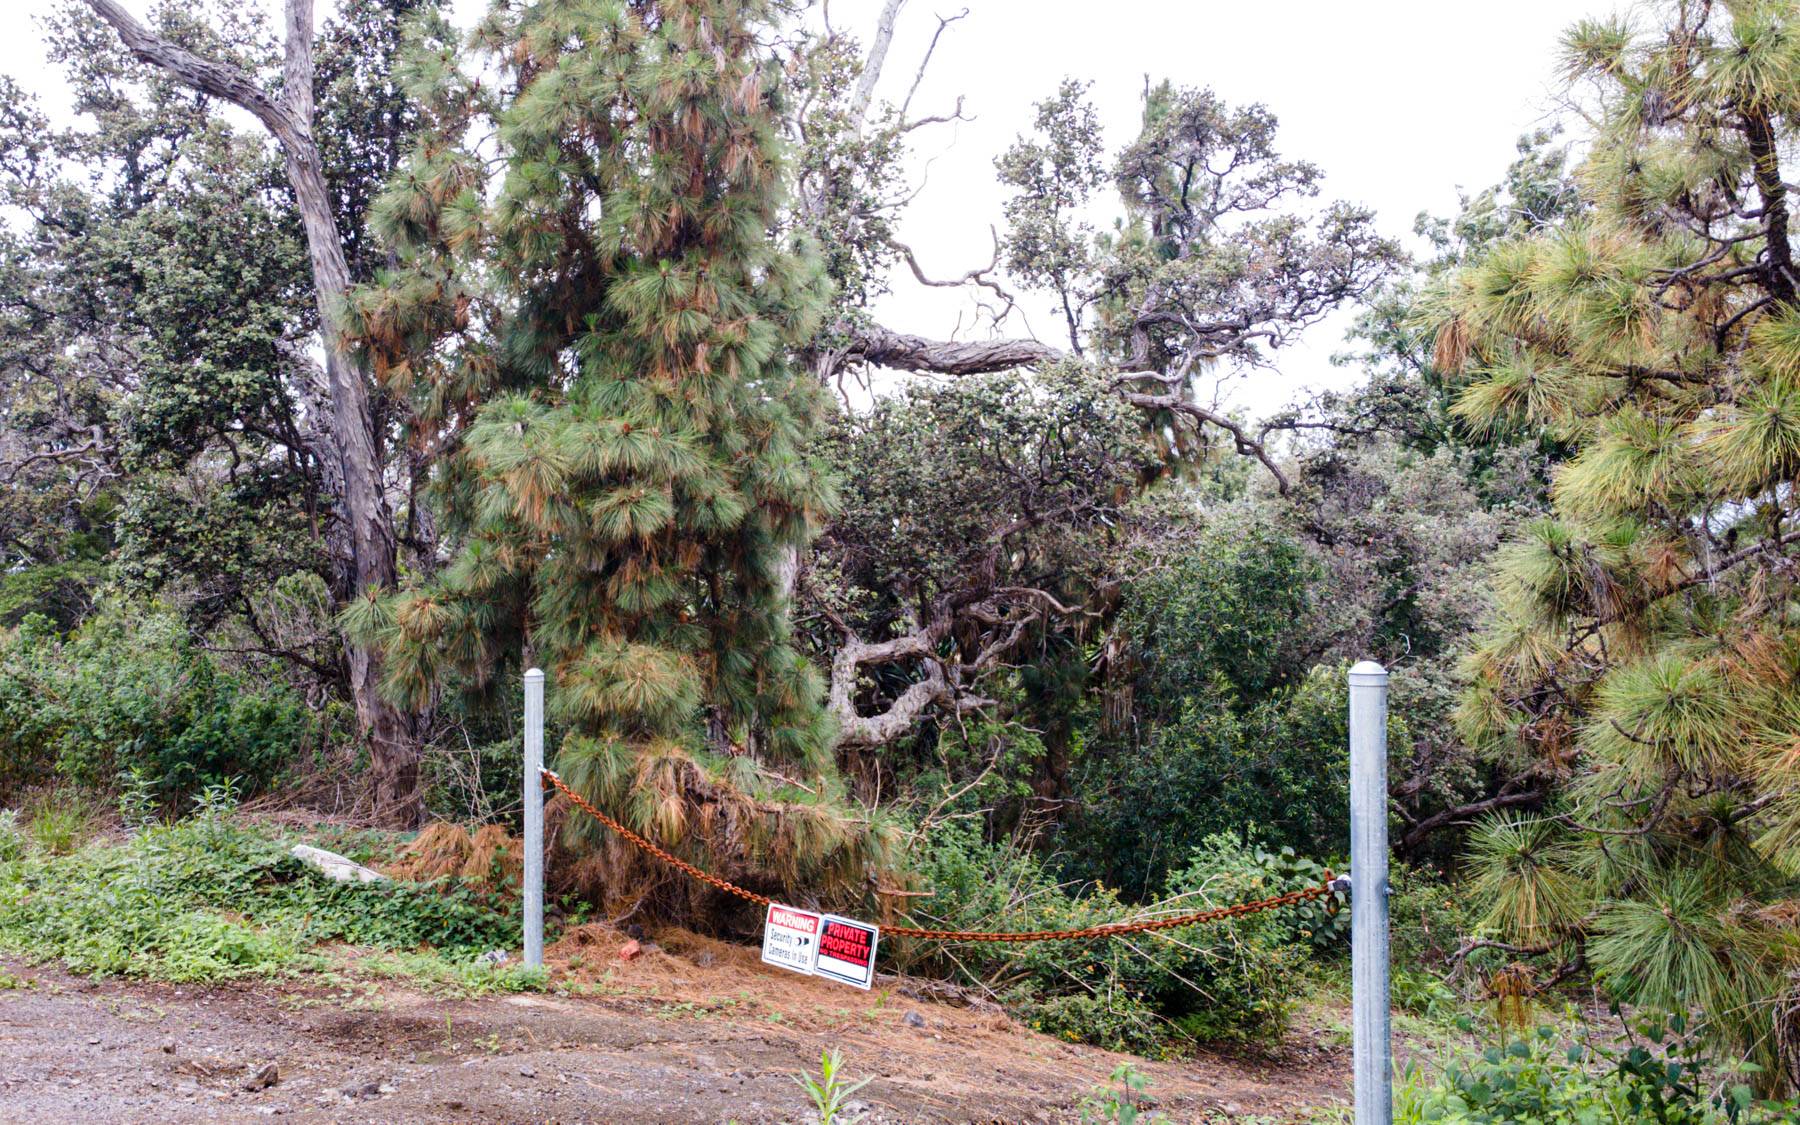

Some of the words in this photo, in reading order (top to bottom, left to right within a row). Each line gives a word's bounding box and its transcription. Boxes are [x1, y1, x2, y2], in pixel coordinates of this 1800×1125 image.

[772, 910, 815, 932] WARNING
[770, 928, 792, 944] Security
[828, 922, 867, 943] PRIVATE
[769, 943, 791, 960] Cameras
[798, 952, 808, 965] Use
[819, 947, 829, 955] NO
[829, 950, 869, 967] TRESPASSING
[821, 935, 870, 959] PROPERTY
